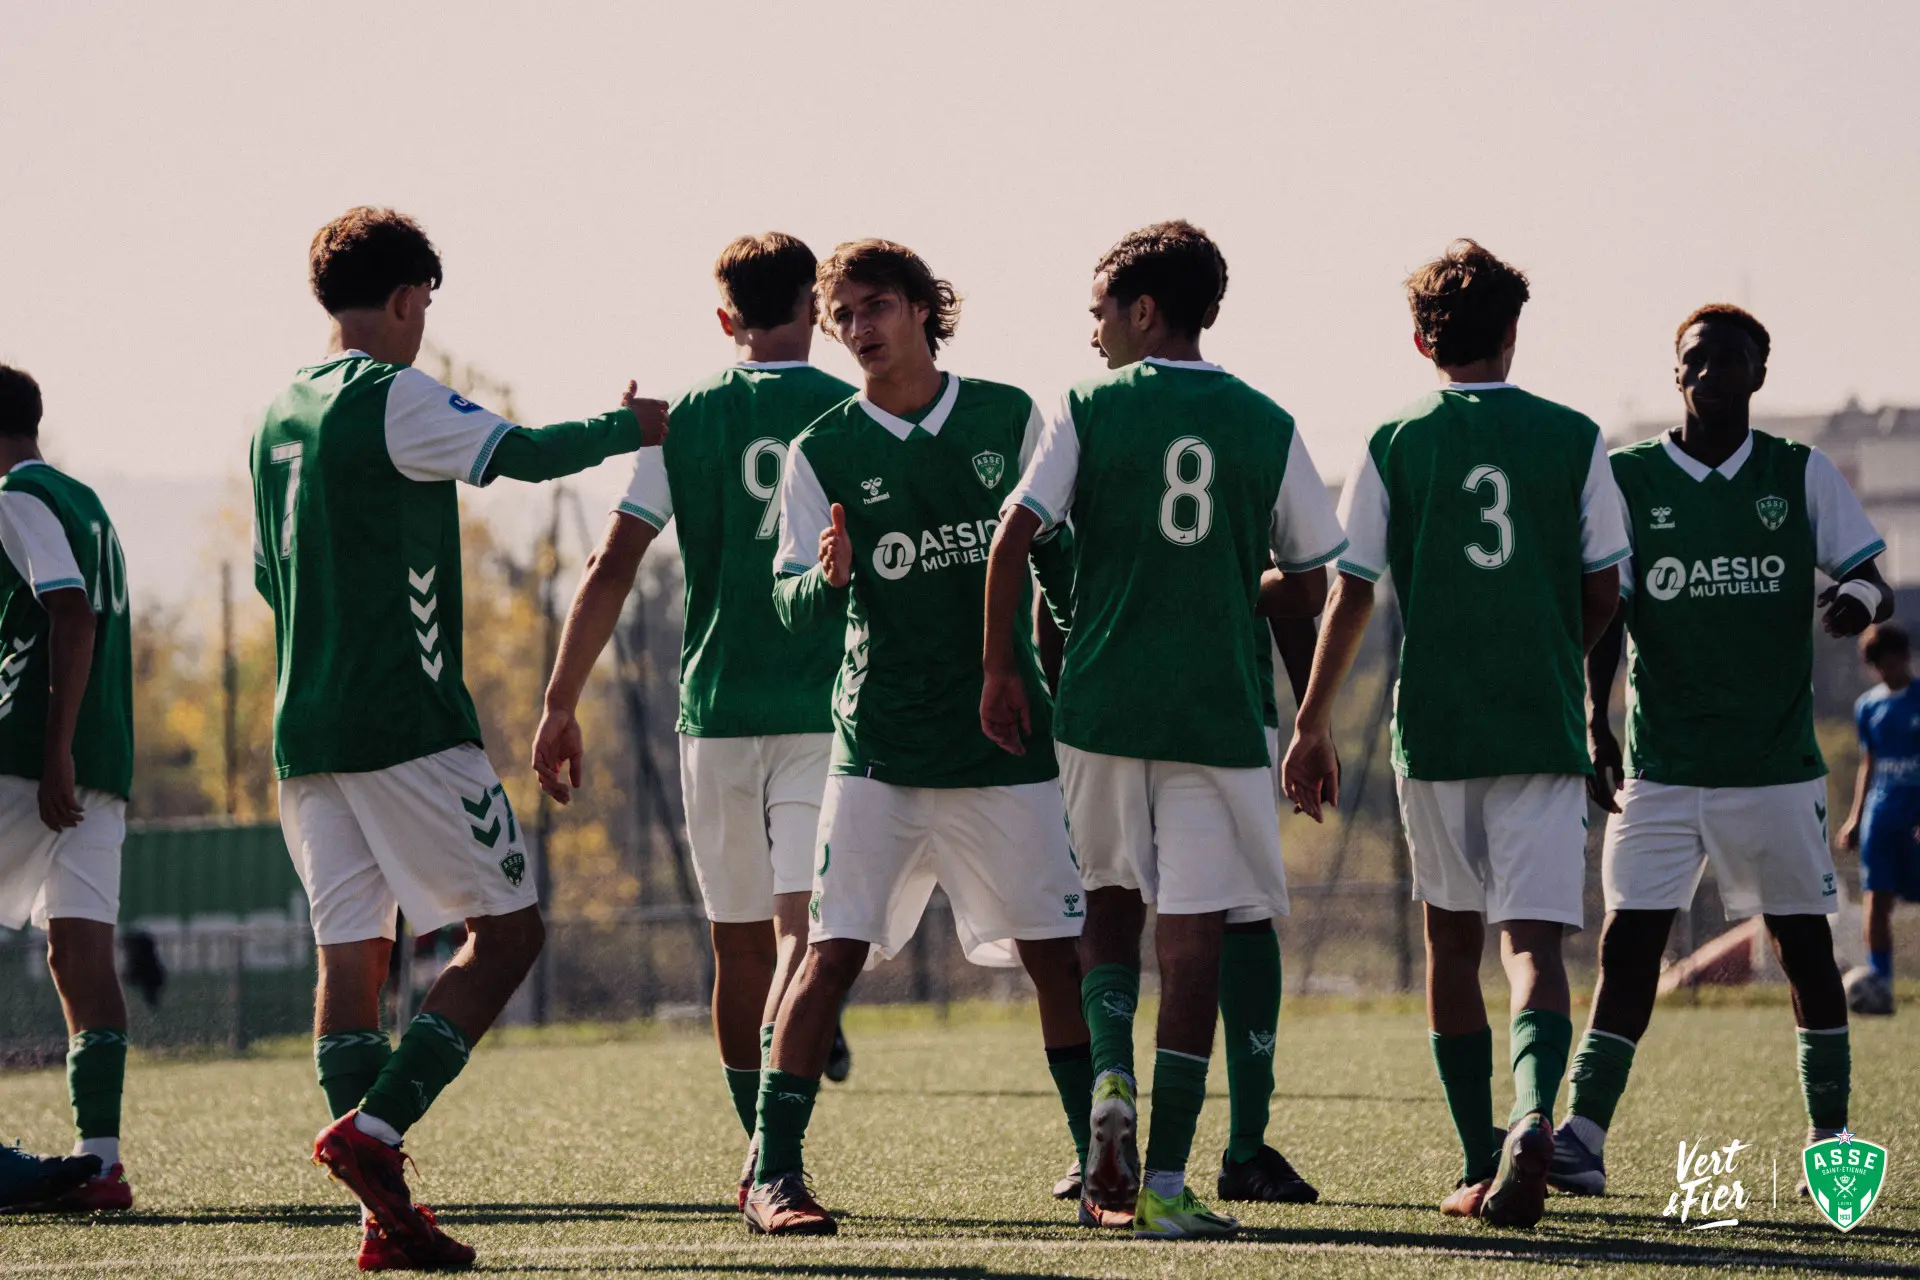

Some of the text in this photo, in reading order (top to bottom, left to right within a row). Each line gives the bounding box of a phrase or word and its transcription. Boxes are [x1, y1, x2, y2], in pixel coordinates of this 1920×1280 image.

[270, 440, 303, 560] 7
[741, 436, 790, 541] 9
[976, 456, 1001, 466] ASSE
[1158, 435, 1215, 546] 8
[921, 547, 990, 572] MUTUEL
[1461, 463, 1515, 569] 3
[90, 520, 129, 617] 10
[1690, 555, 1786, 583] AÉSIO
[1690, 580, 1780, 598] MUTUELLE
